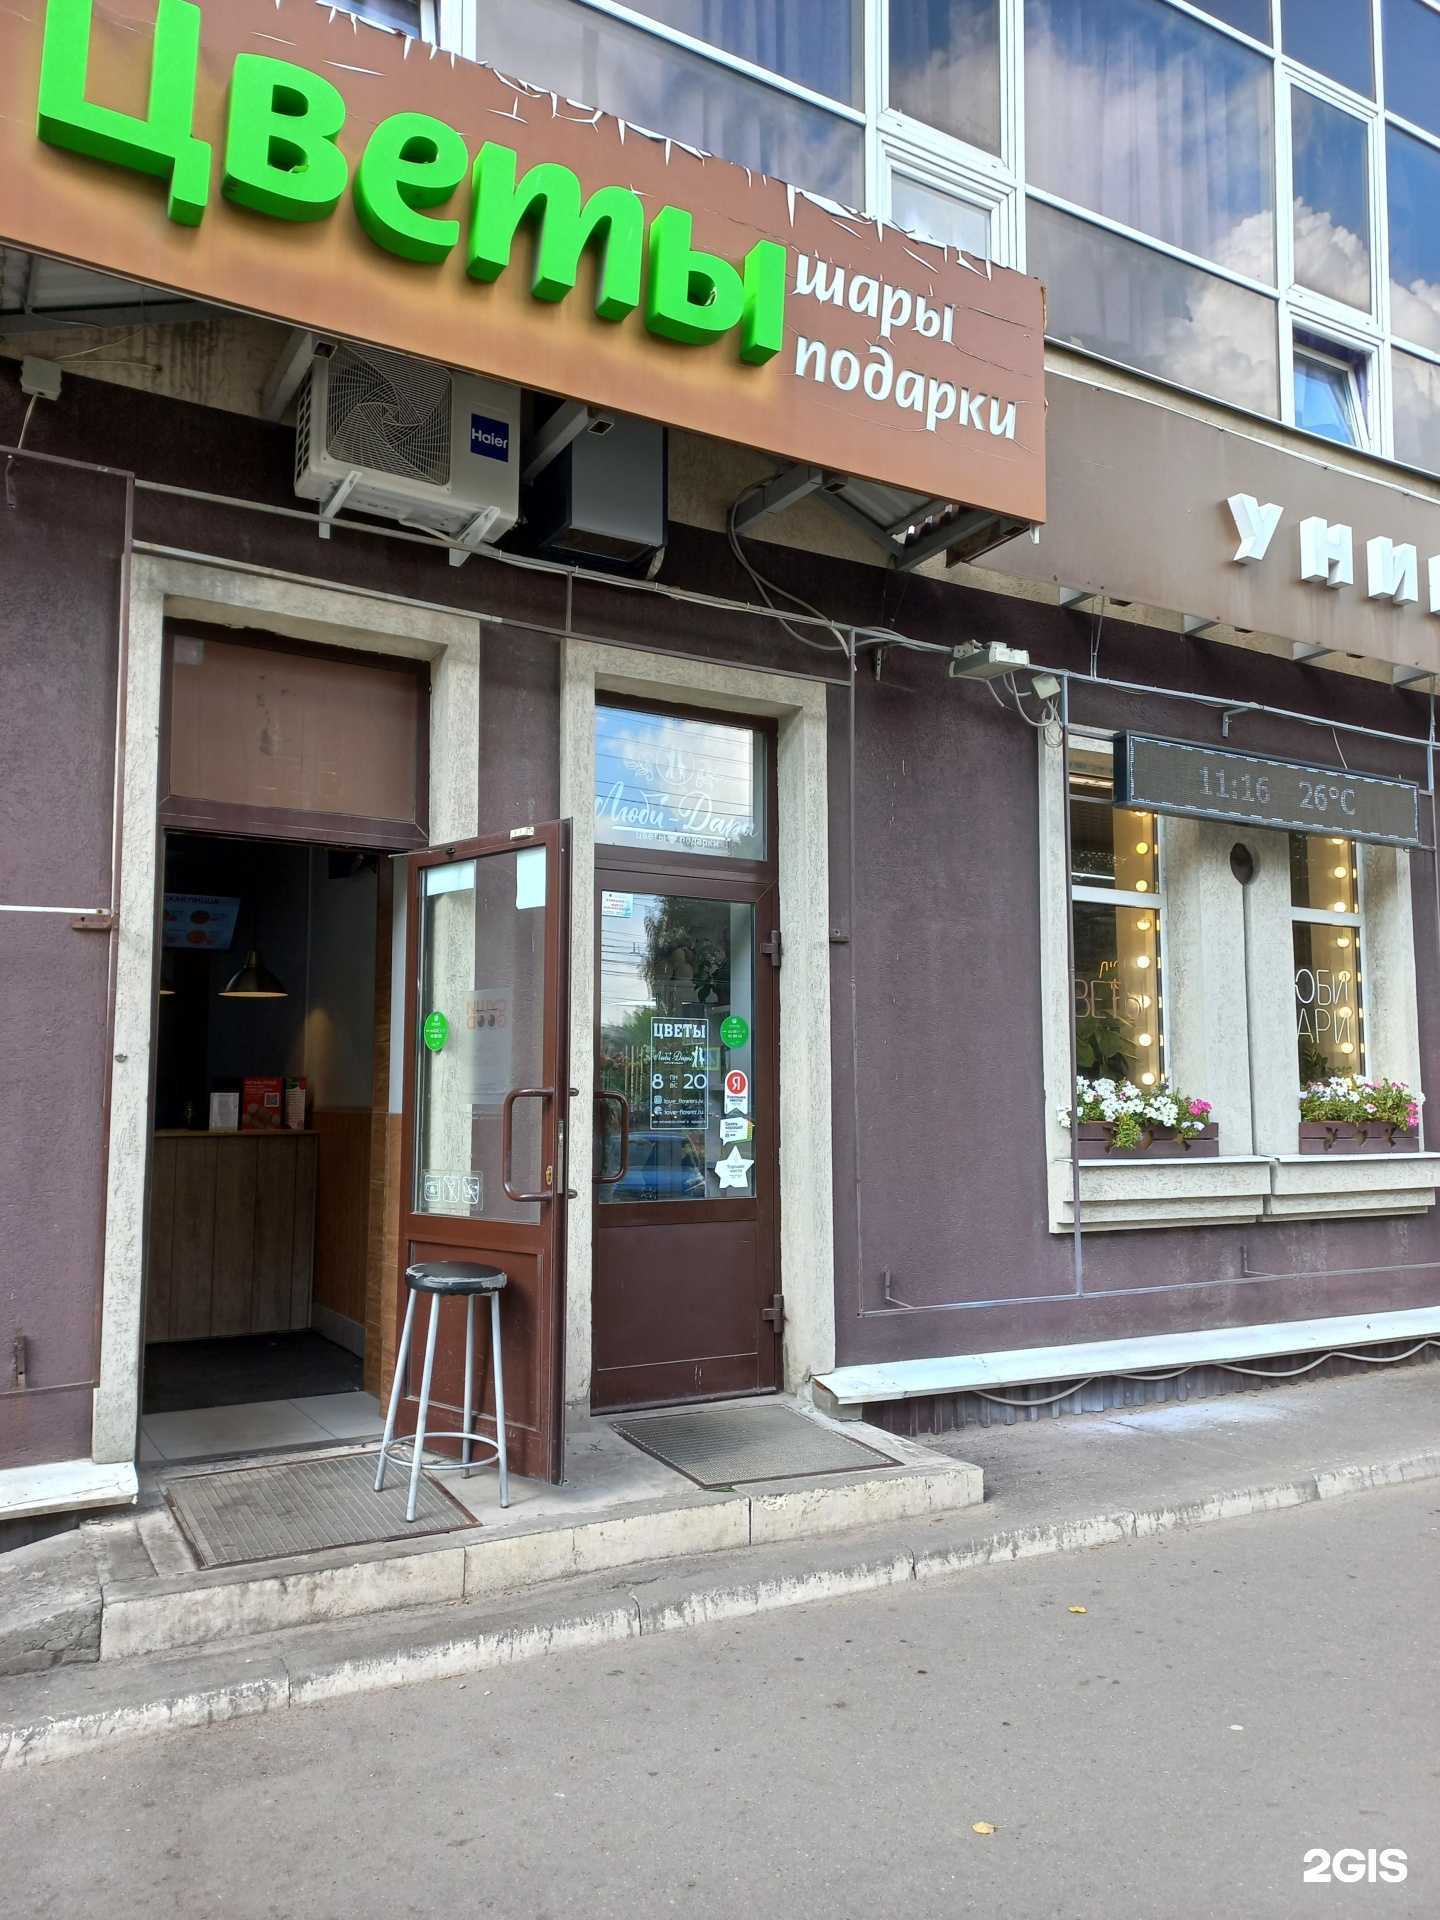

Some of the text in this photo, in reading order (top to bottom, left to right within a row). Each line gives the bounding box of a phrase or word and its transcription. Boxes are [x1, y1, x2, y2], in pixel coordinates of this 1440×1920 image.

[38, 0, 786, 366] Цветы
[792, 254, 955, 344] шары
[795, 334, 1016, 435] подарки
[471, 428, 508, 449] Haier
[1200, 766, 1271, 803] 11:16
[653, 1023, 706, 1040] ЦВЕТЫ
[652, 1073, 664, 1089] 8
[683, 1073, 707, 1089] 20
[732, 1076, 741, 1091] Я
